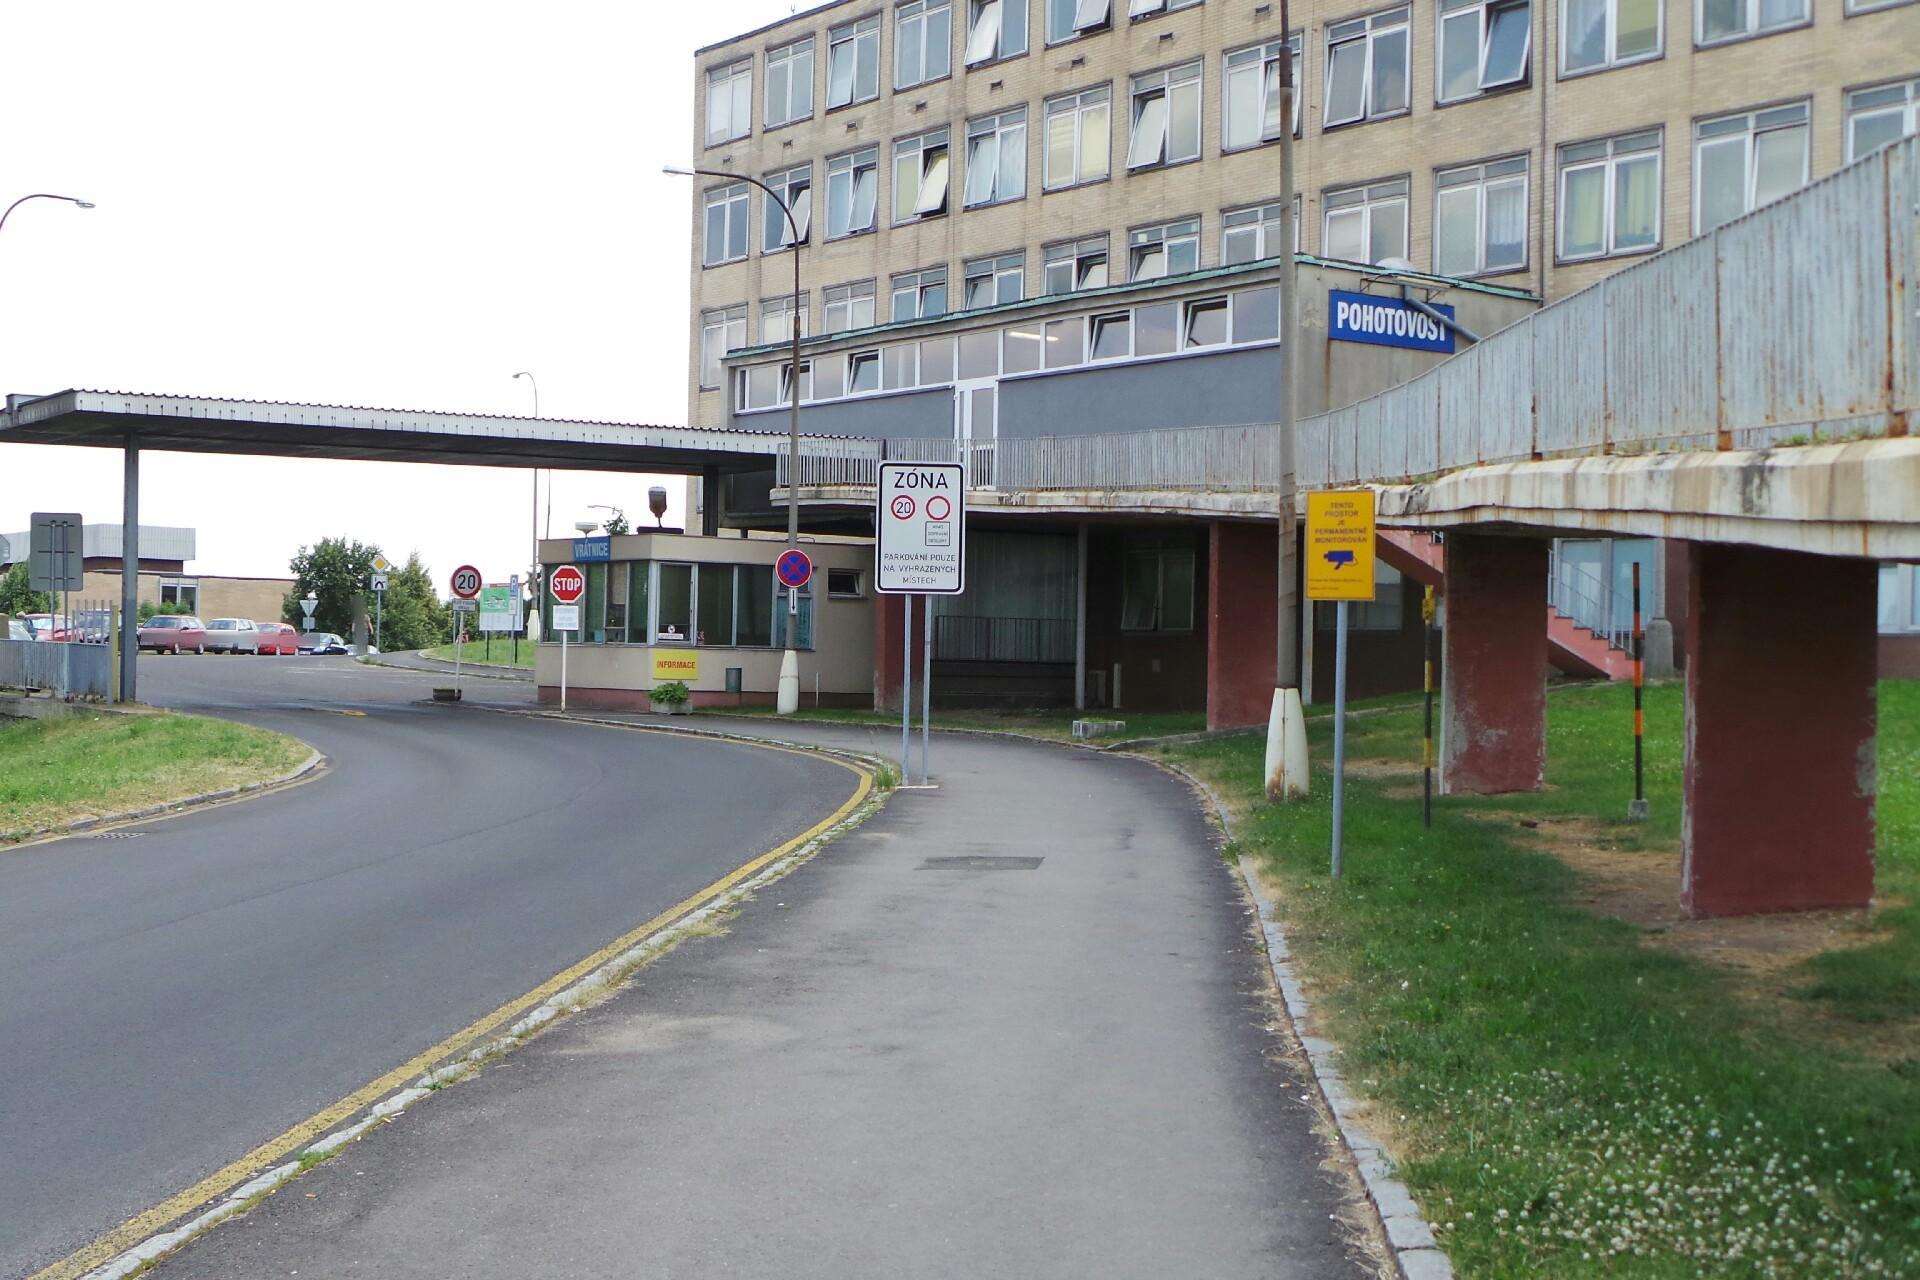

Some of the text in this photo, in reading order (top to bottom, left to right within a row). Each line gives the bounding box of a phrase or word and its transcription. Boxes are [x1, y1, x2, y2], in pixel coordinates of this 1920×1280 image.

[1337, 301, 1447, 341] POHOTOVOST
[894, 468, 948, 489] ZÓNA
[896, 501, 911, 514] 20
[574, 540, 608, 558] VRÁTNICE
[930, 554, 956, 562] POUZE
[883, 564, 895, 573] NA
[457, 574, 476, 590] 20
[554, 577, 581, 591] STOP
[902, 575, 936, 584] MÍSTECH
[656, 660, 697, 669] INFORMACE
